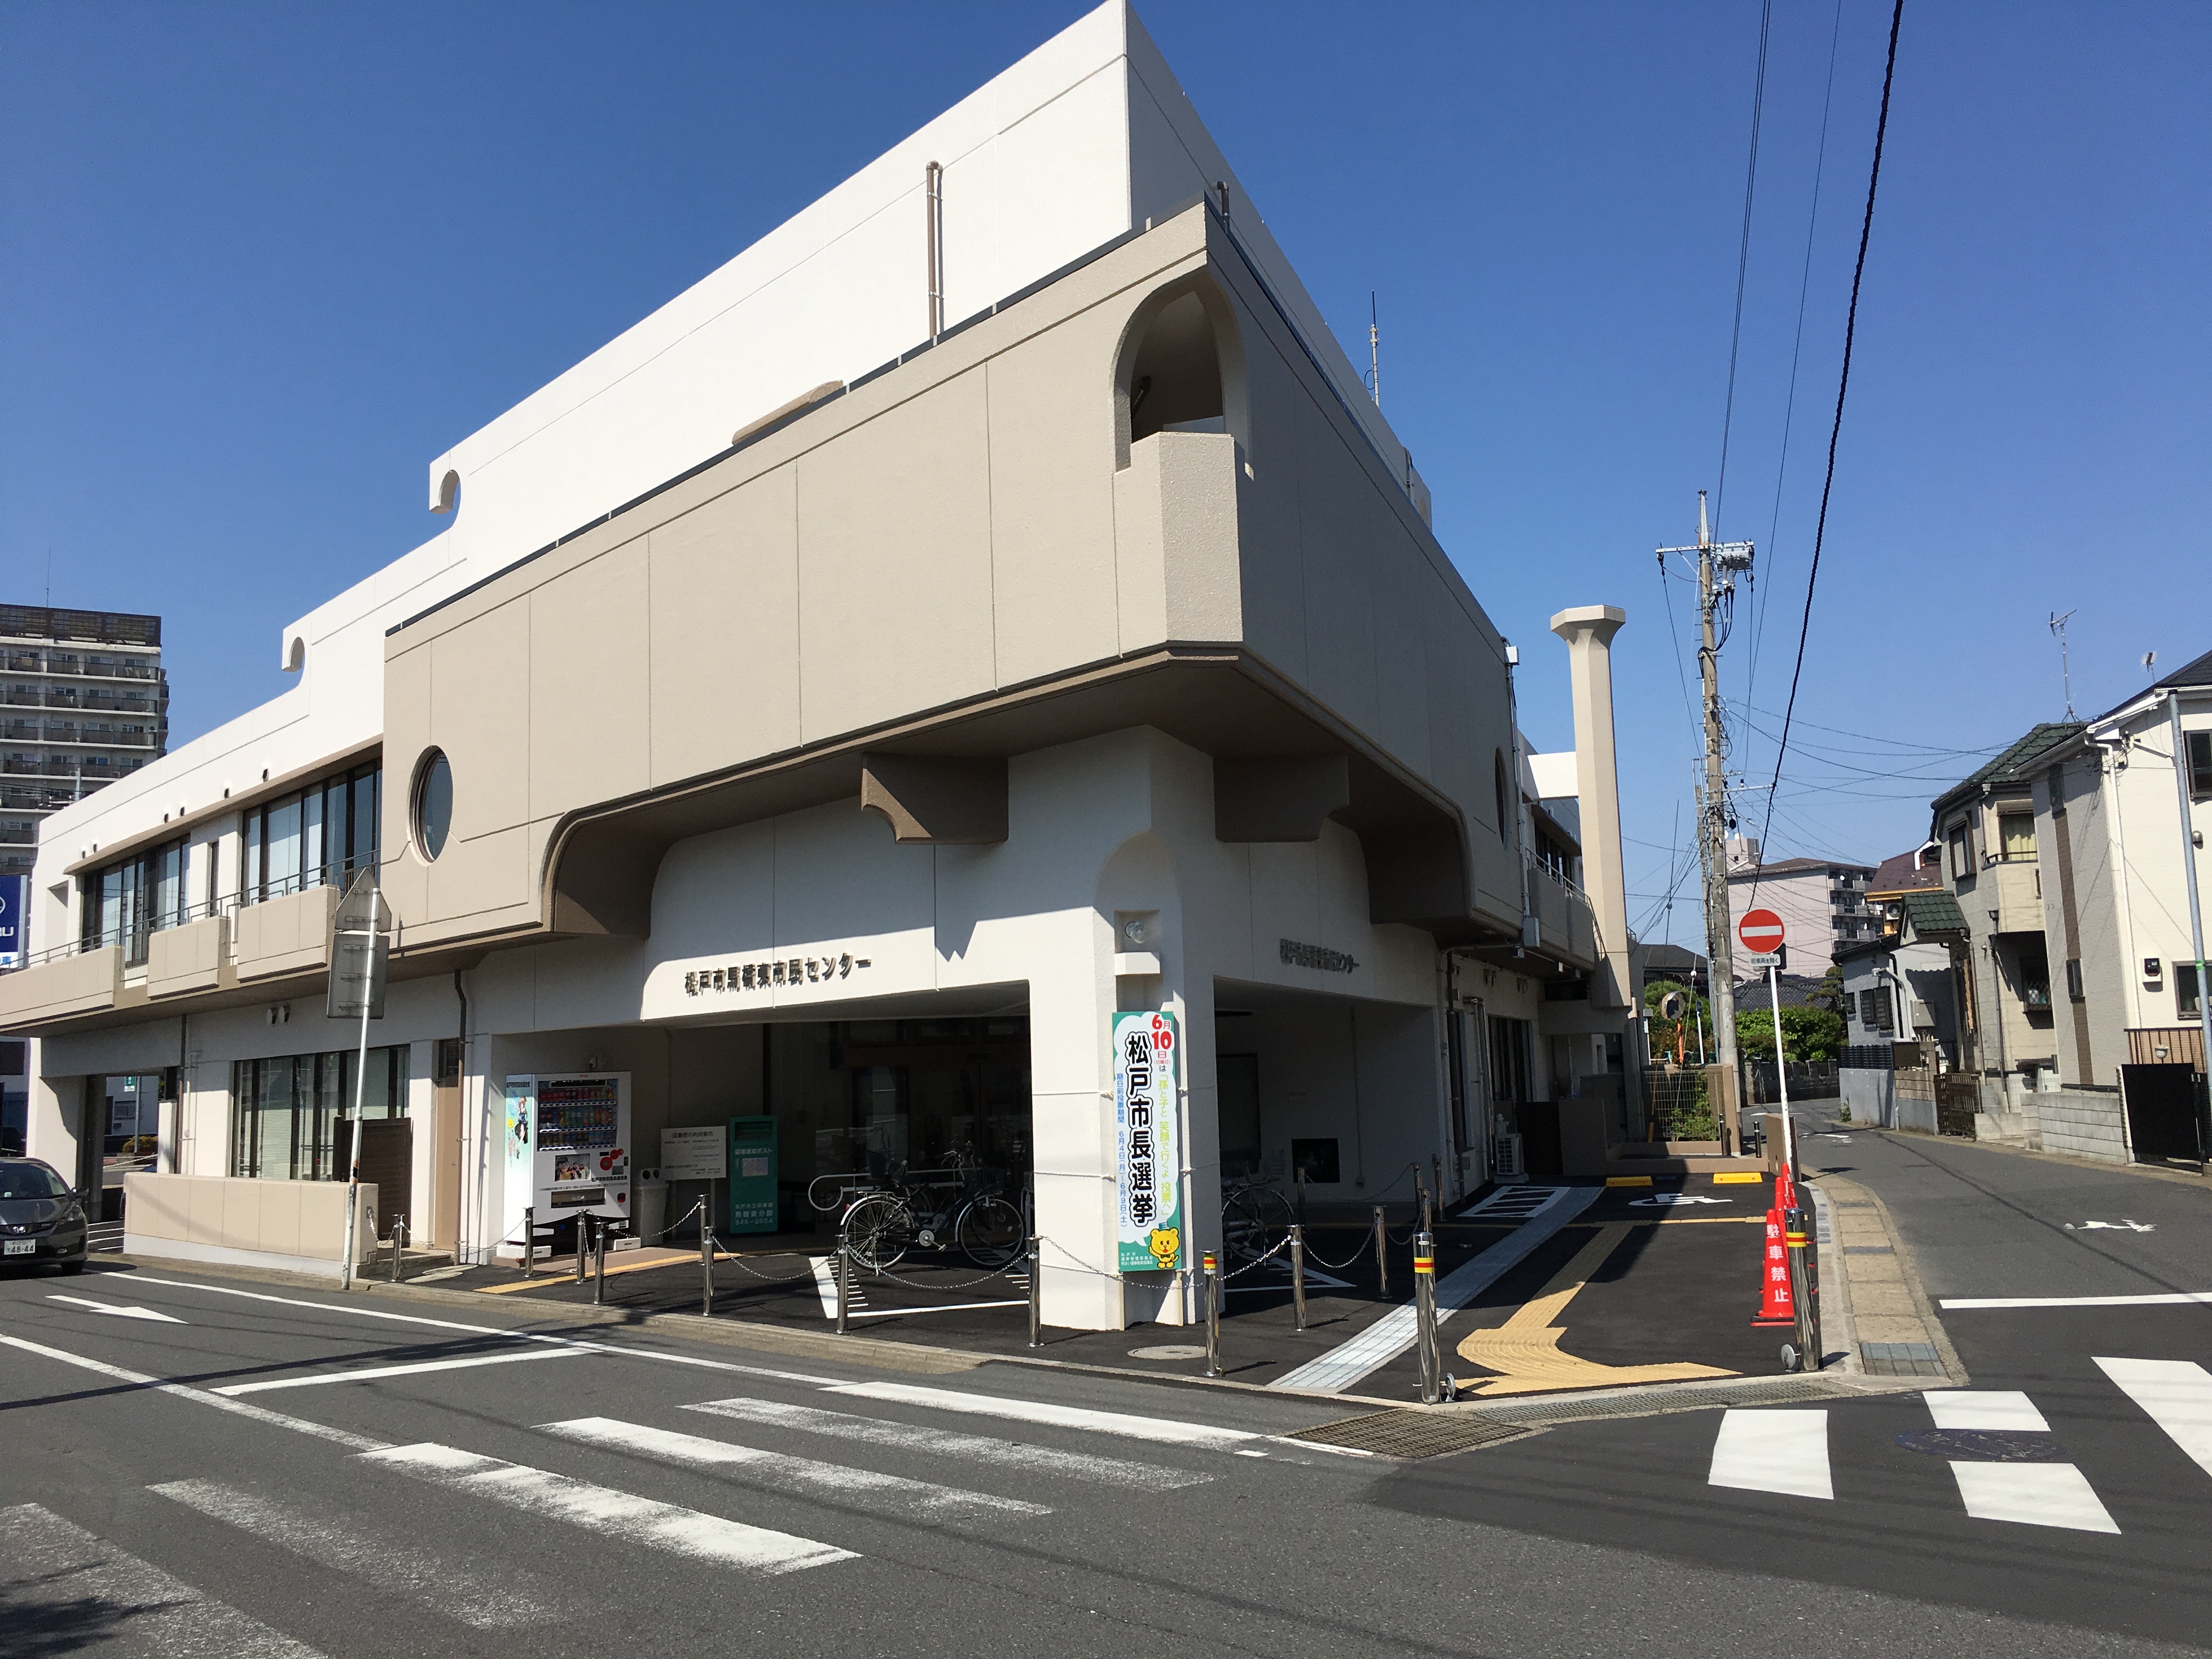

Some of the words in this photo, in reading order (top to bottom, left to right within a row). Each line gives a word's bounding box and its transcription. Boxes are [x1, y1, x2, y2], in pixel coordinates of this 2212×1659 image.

[0, 927, 14, 936] U
[685, 952, 872, 997] 松戸市馬橋東市民センター
[1127, 1034, 1153, 1224] 松戸市長選挙
[1767, 1224, 1790, 1302] 駐車禁止
